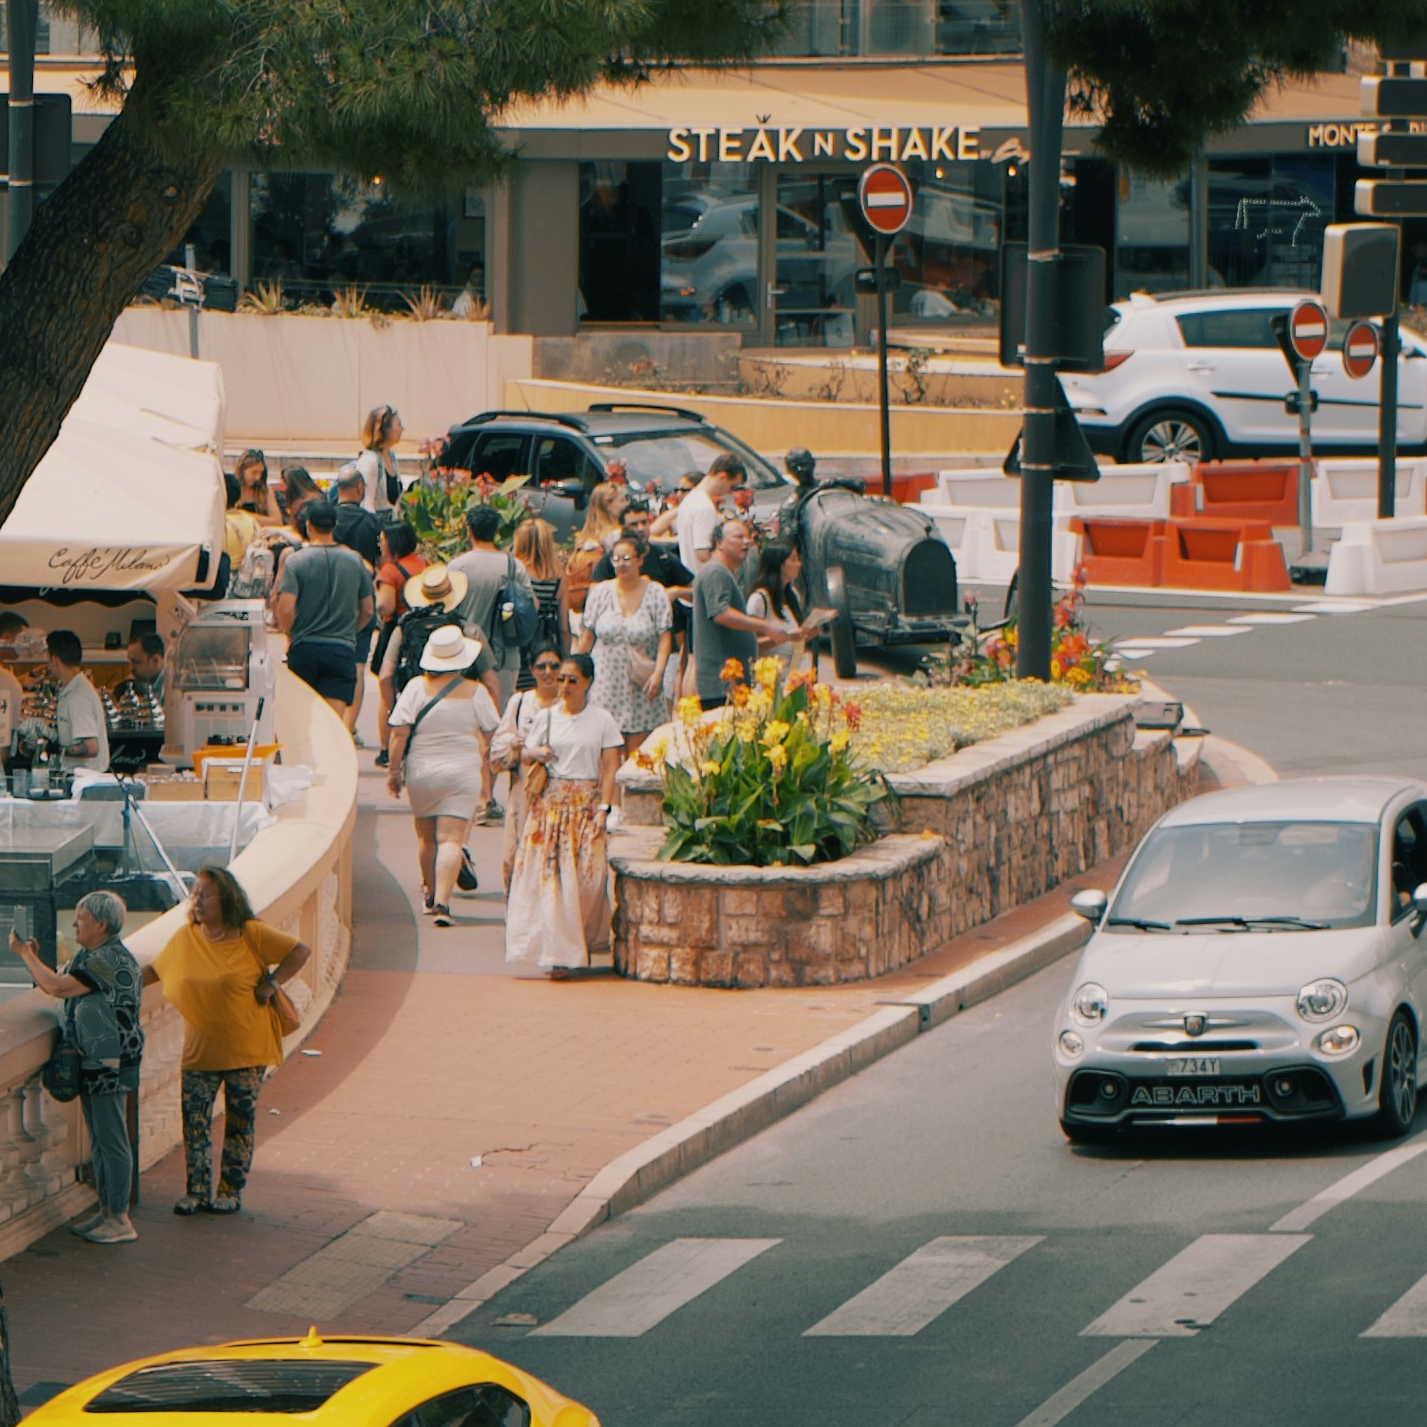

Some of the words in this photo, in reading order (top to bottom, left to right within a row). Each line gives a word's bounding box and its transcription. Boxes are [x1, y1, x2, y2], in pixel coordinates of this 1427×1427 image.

[667, 127, 804, 162] STEAK
[813, 131, 834, 156] N
[844, 125, 982, 161] SHAKE
[1179, 1058, 1220, 1074] 734Y
[1131, 1084, 1260, 1106] ABARTH
